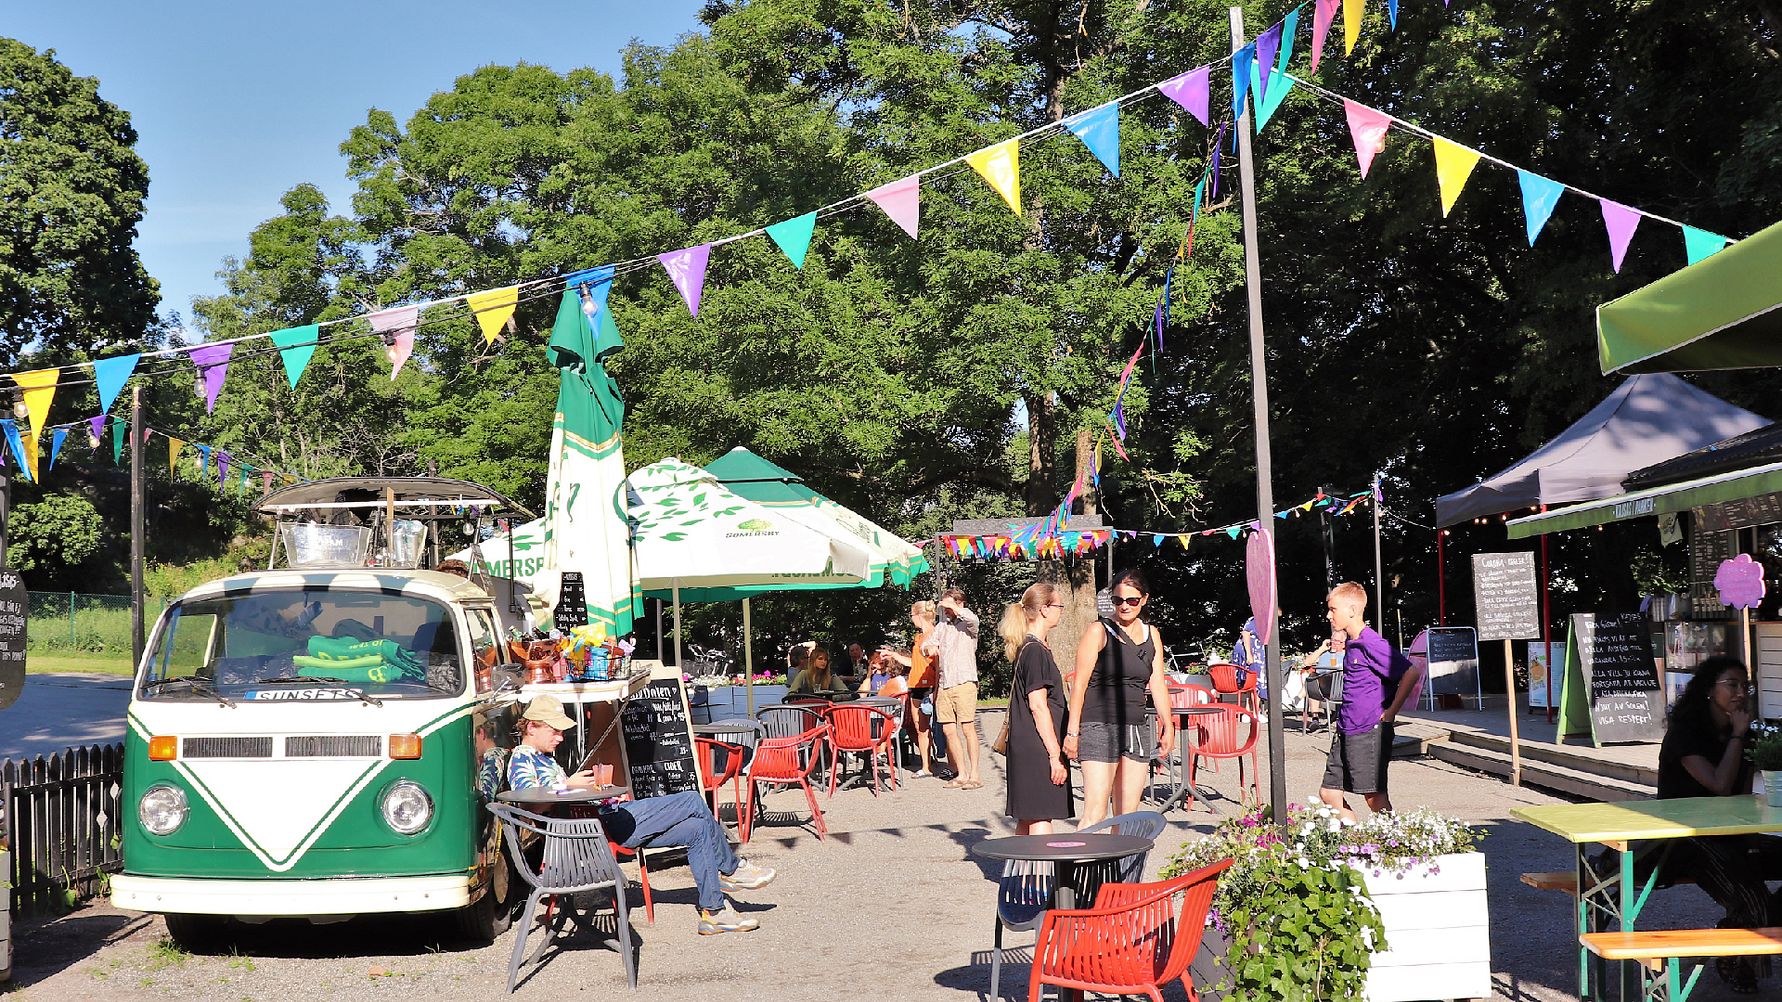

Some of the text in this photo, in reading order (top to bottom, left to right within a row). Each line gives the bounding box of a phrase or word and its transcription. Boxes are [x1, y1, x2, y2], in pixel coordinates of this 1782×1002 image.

[465, 557, 544, 577] MERS
[260, 688, 357, 700] SUNSETS
[1614, 702, 1624, 712] AV
[1617, 712, 1653, 726] RESPEKT!
